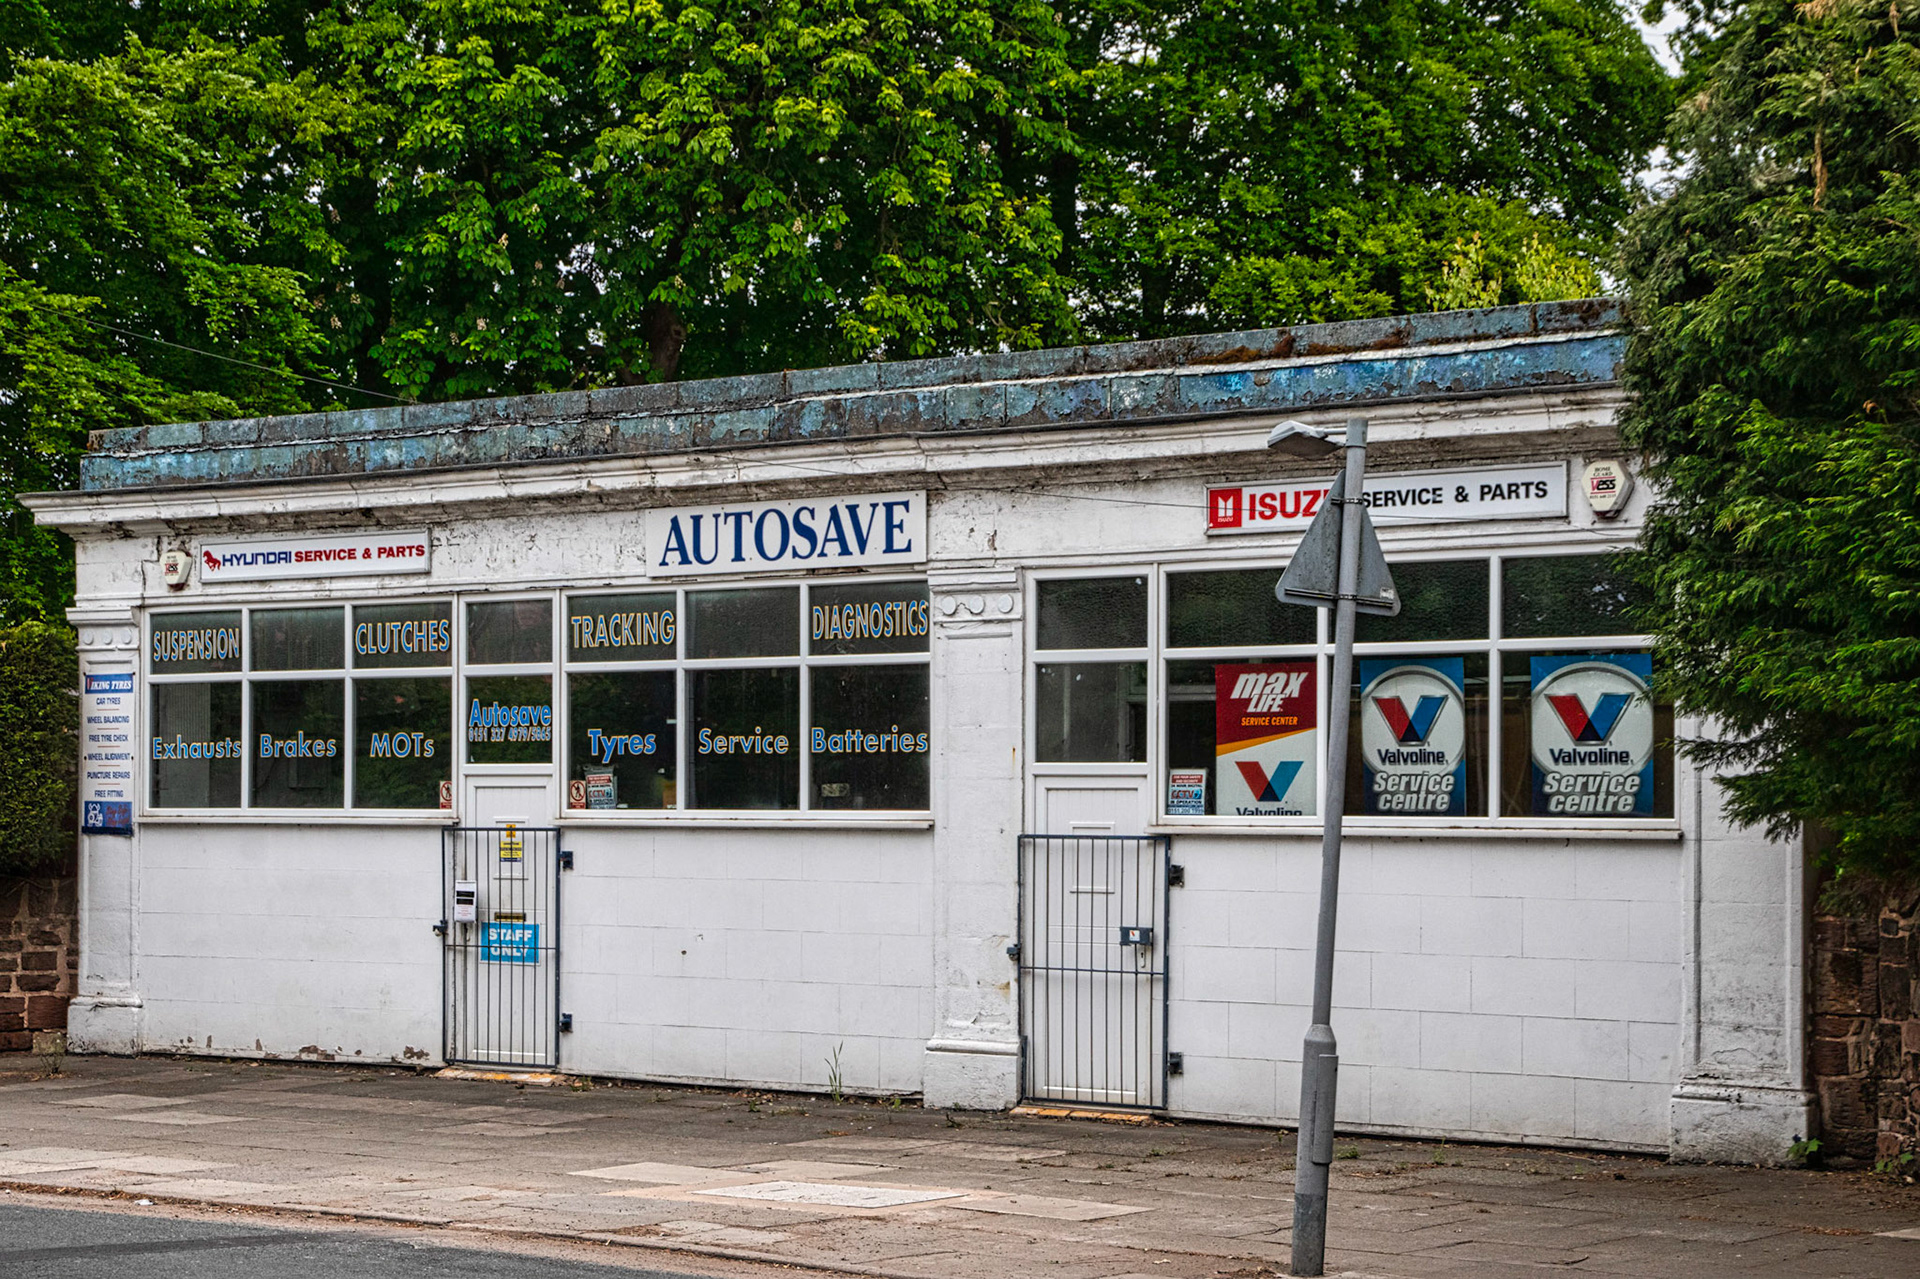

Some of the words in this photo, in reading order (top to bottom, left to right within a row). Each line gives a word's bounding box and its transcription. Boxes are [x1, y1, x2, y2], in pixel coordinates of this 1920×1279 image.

[1249, 488, 1331, 521] ISUZ
[1362, 486, 1443, 509] SERVICE
[1454, 484, 1470, 504] &
[1480, 480, 1549, 501] PARTS
[658, 499, 912, 567] AUTOSAVE
[222, 550, 292, 567] HYUNDAI
[294, 548, 357, 563] SERVICE
[362, 547, 373, 560] &
[377, 544, 426, 558] PARTS
[571, 610, 676, 648] TRACKING
[813, 599, 929, 641] DIAGNOSTICS
[153, 627, 240, 662] SUSPENSION
[355, 619, 450, 655] CLUTCHES
[111, 680, 132, 690] TYRES
[1230, 672, 1309, 699] max
[96, 697, 106, 705] CAR
[107, 697, 121, 705] TYRES
[1247, 694, 1287, 713] LIFE
[87, 716, 103, 724] WHEEL
[103, 715, 130, 724] BALANCING
[469, 698, 552, 728] Autosave
[1241, 717, 1270, 726] SERVICE
[1271, 716, 1298, 726] CENTER
[89, 734, 100, 742] FREE
[101, 734, 112, 742] TYRE
[113, 734, 129, 742] CHECK
[259, 730, 338, 758] Brakes
[369, 732, 435, 758] MOTs
[469, 727, 489, 743] 0151
[491, 727, 506, 743] 327
[588, 728, 657, 764] Tyres
[698, 727, 790, 755] Service
[811, 725, 929, 753] Batteries
[87, 752, 103, 760] WHEEL
[104, 752, 130, 760] ALIGNMENT
[152, 734, 242, 760] Exhausts
[1377, 748, 1446, 765] Valvoline
[1548, 748, 1630, 765] Valvoline
[87, 771, 112, 779] PUNCTURE
[112, 771, 131, 779] REPAIRS
[1374, 771, 1455, 793] Service
[1544, 771, 1641, 794] Service
[94, 790, 106, 798] FREE
[107, 789, 124, 798] FITTING
[1171, 790, 1194, 799] CCTV
[1379, 792, 1450, 811] centre
[1549, 793, 1634, 812] centre
[489, 927, 533, 942] STAFF
[491, 943, 530, 957] ONLY
